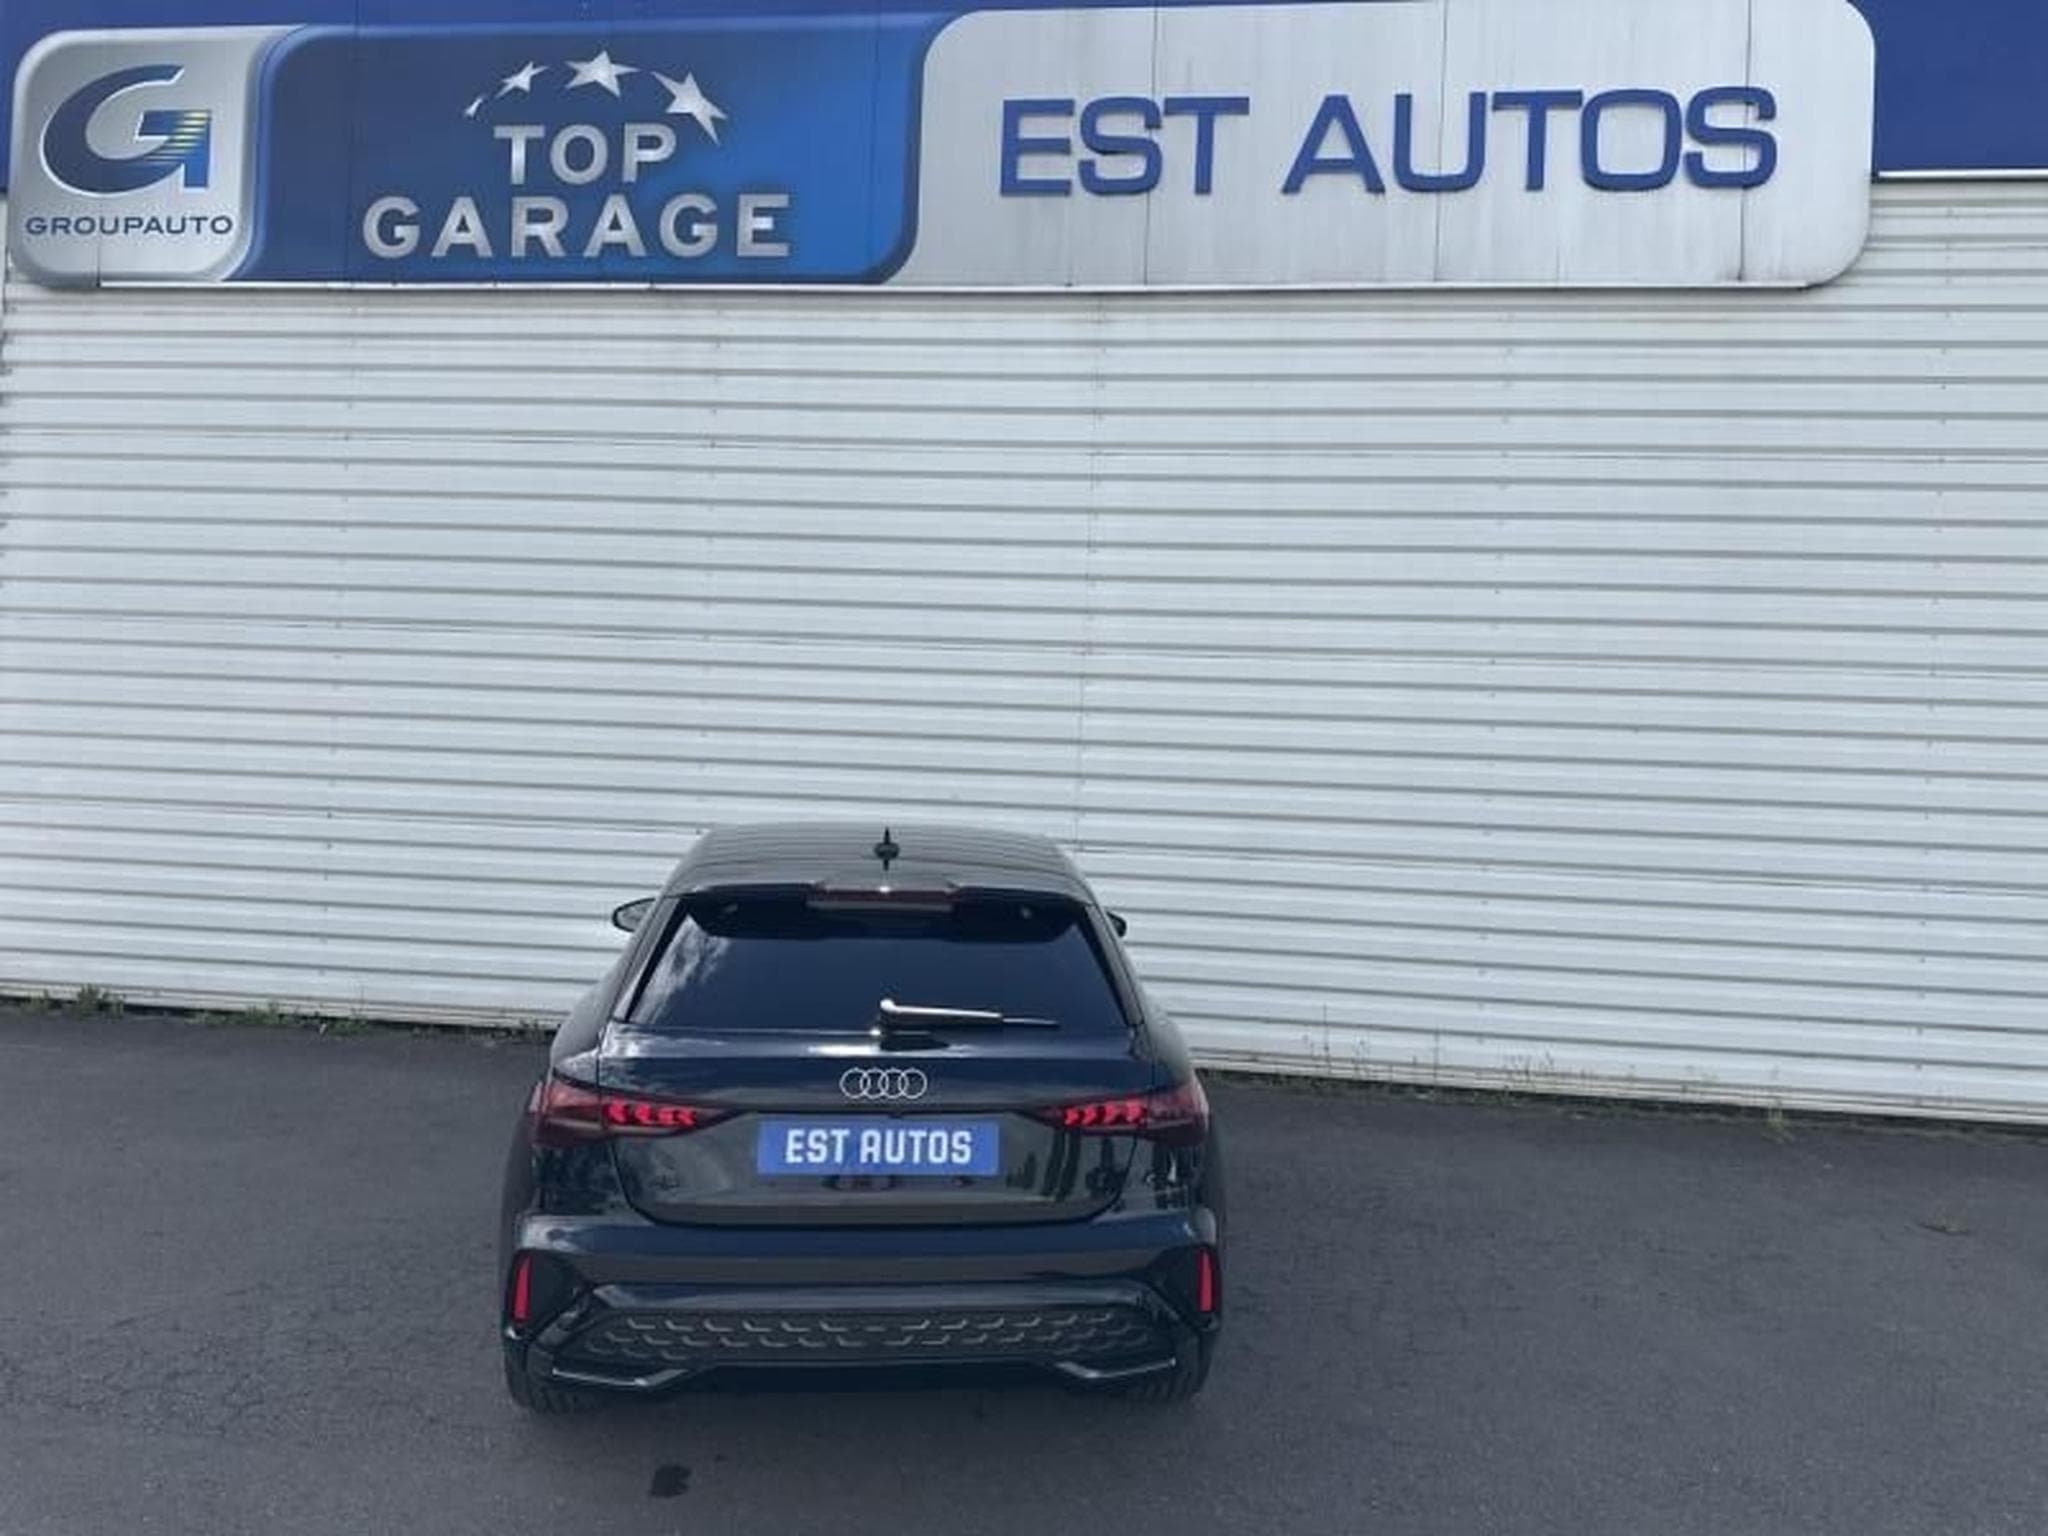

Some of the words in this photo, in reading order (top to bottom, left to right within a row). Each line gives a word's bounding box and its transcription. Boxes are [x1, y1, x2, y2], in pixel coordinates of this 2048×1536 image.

[494, 123, 678, 186] TOP
[1000, 96, 1250, 197] EST
[1281, 86, 1778, 195] AUTOS
[25, 214, 233, 237] GROUPAUTO
[362, 194, 793, 260] GARAGE
[785, 1128, 850, 1165] EST
[859, 1128, 973, 1165] AUTOS
